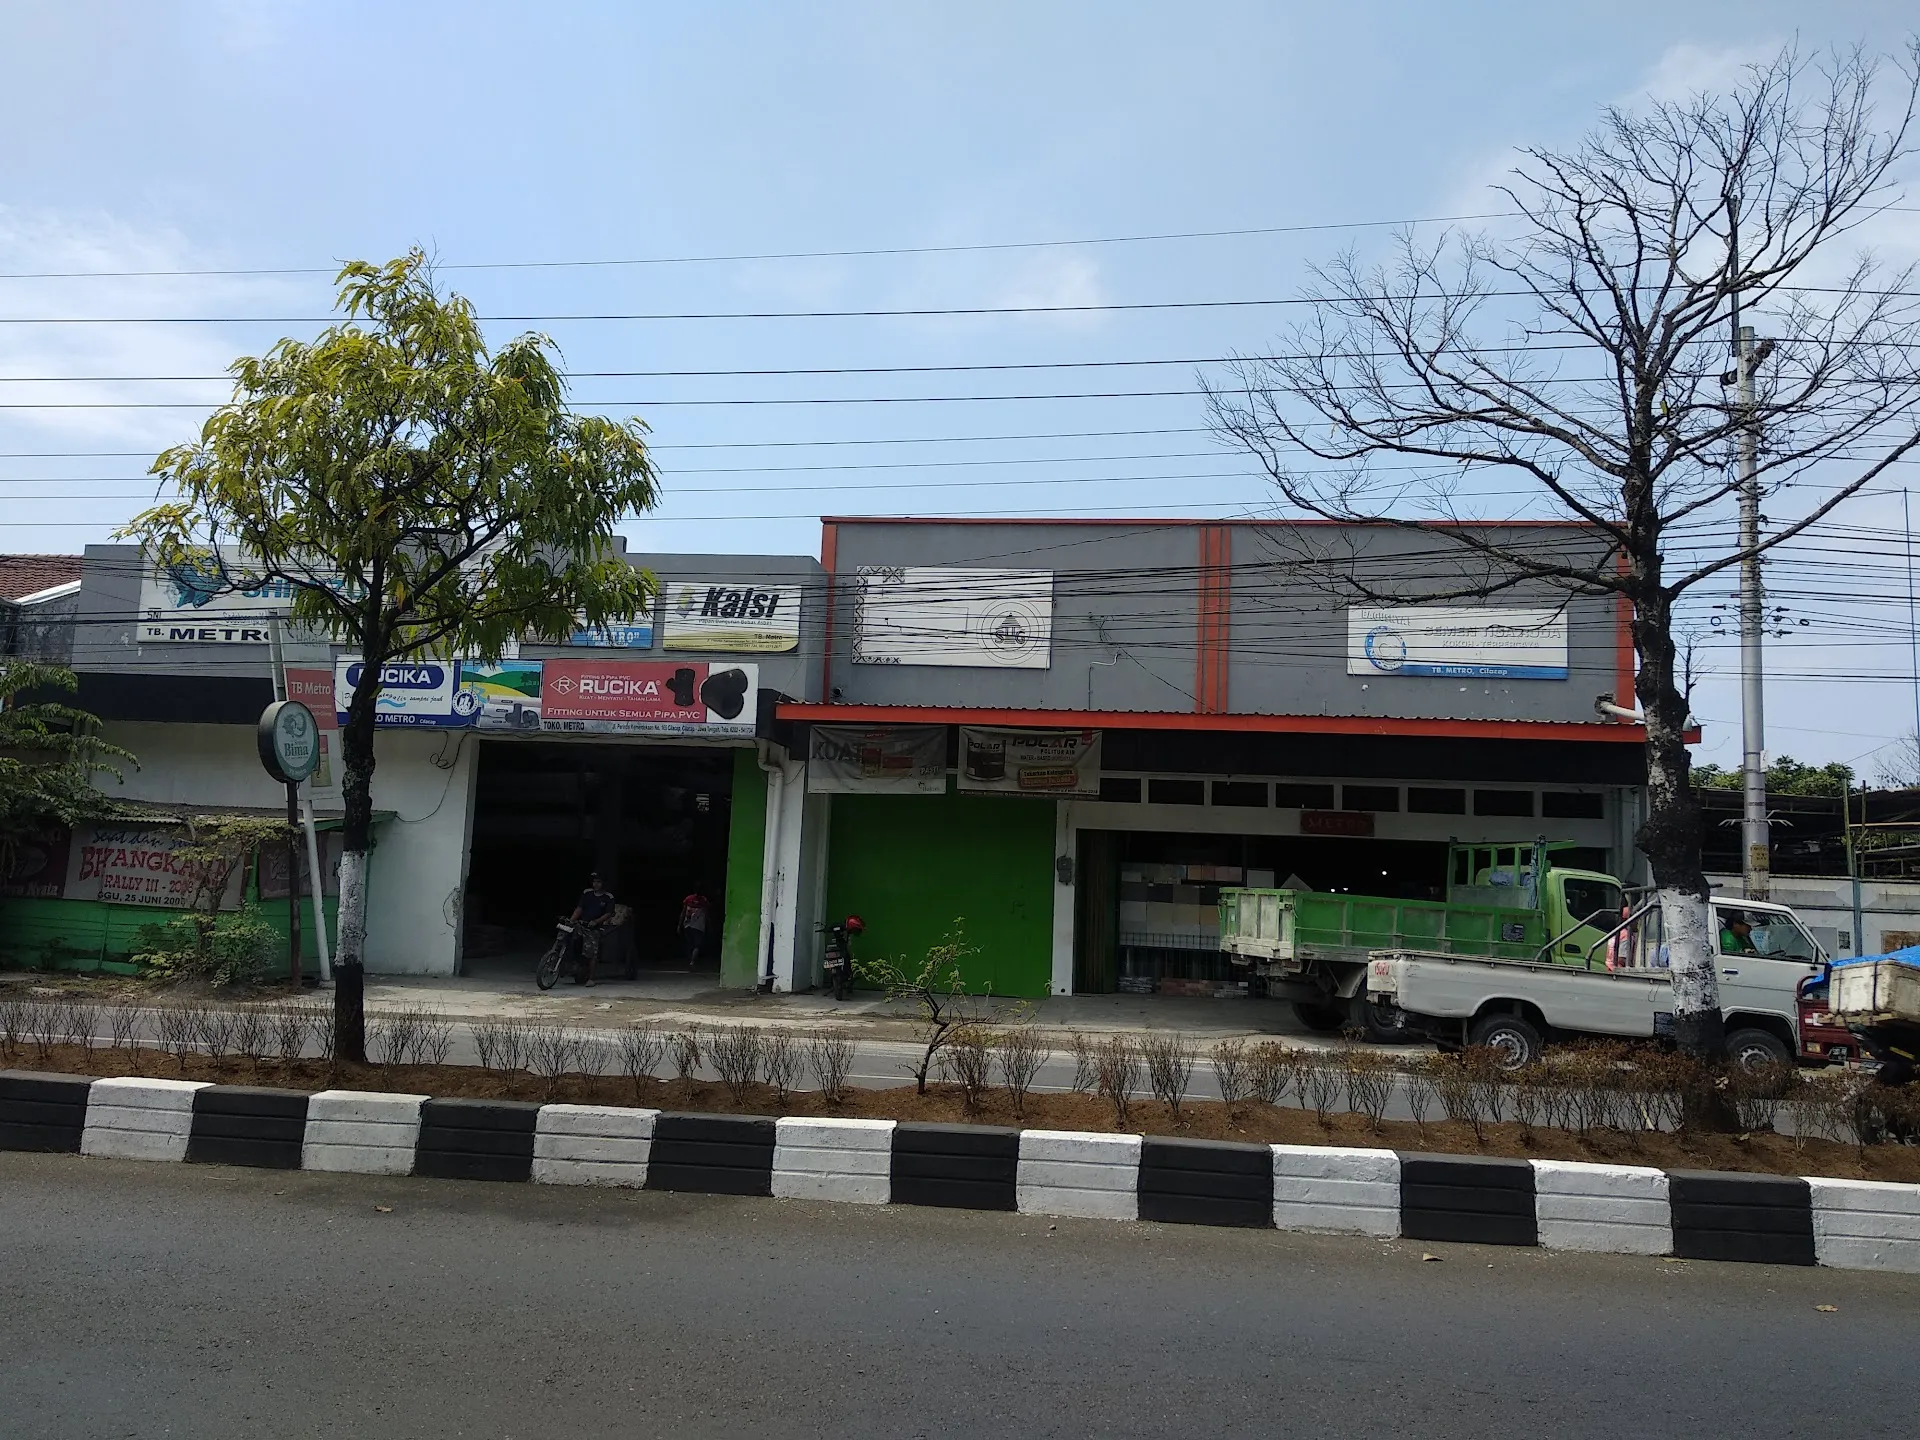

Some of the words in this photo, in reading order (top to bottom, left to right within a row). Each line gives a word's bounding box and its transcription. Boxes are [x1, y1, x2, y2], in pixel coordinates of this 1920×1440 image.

[700, 587, 780, 619] Kalsi
[146, 627, 165, 636] TB.
[169, 628, 270, 641] METR
[359, 668, 432, 684] UCIKA
[1479, 668, 1508, 676] Cilacap
[291, 681, 303, 694] TB
[304, 682, 331, 695] Metro
[385, 715, 416, 723] METRO
[678, 711, 701, 719] PVC
[563, 722, 585, 731] METRO
[284, 741, 309, 757] Bima
[969, 741, 1001, 750] POLAR
[103, 874, 144, 891] RALLY
[145, 878, 159, 892] III
[125, 894, 136, 902] 25
[138, 895, 162, 904] JUNI
